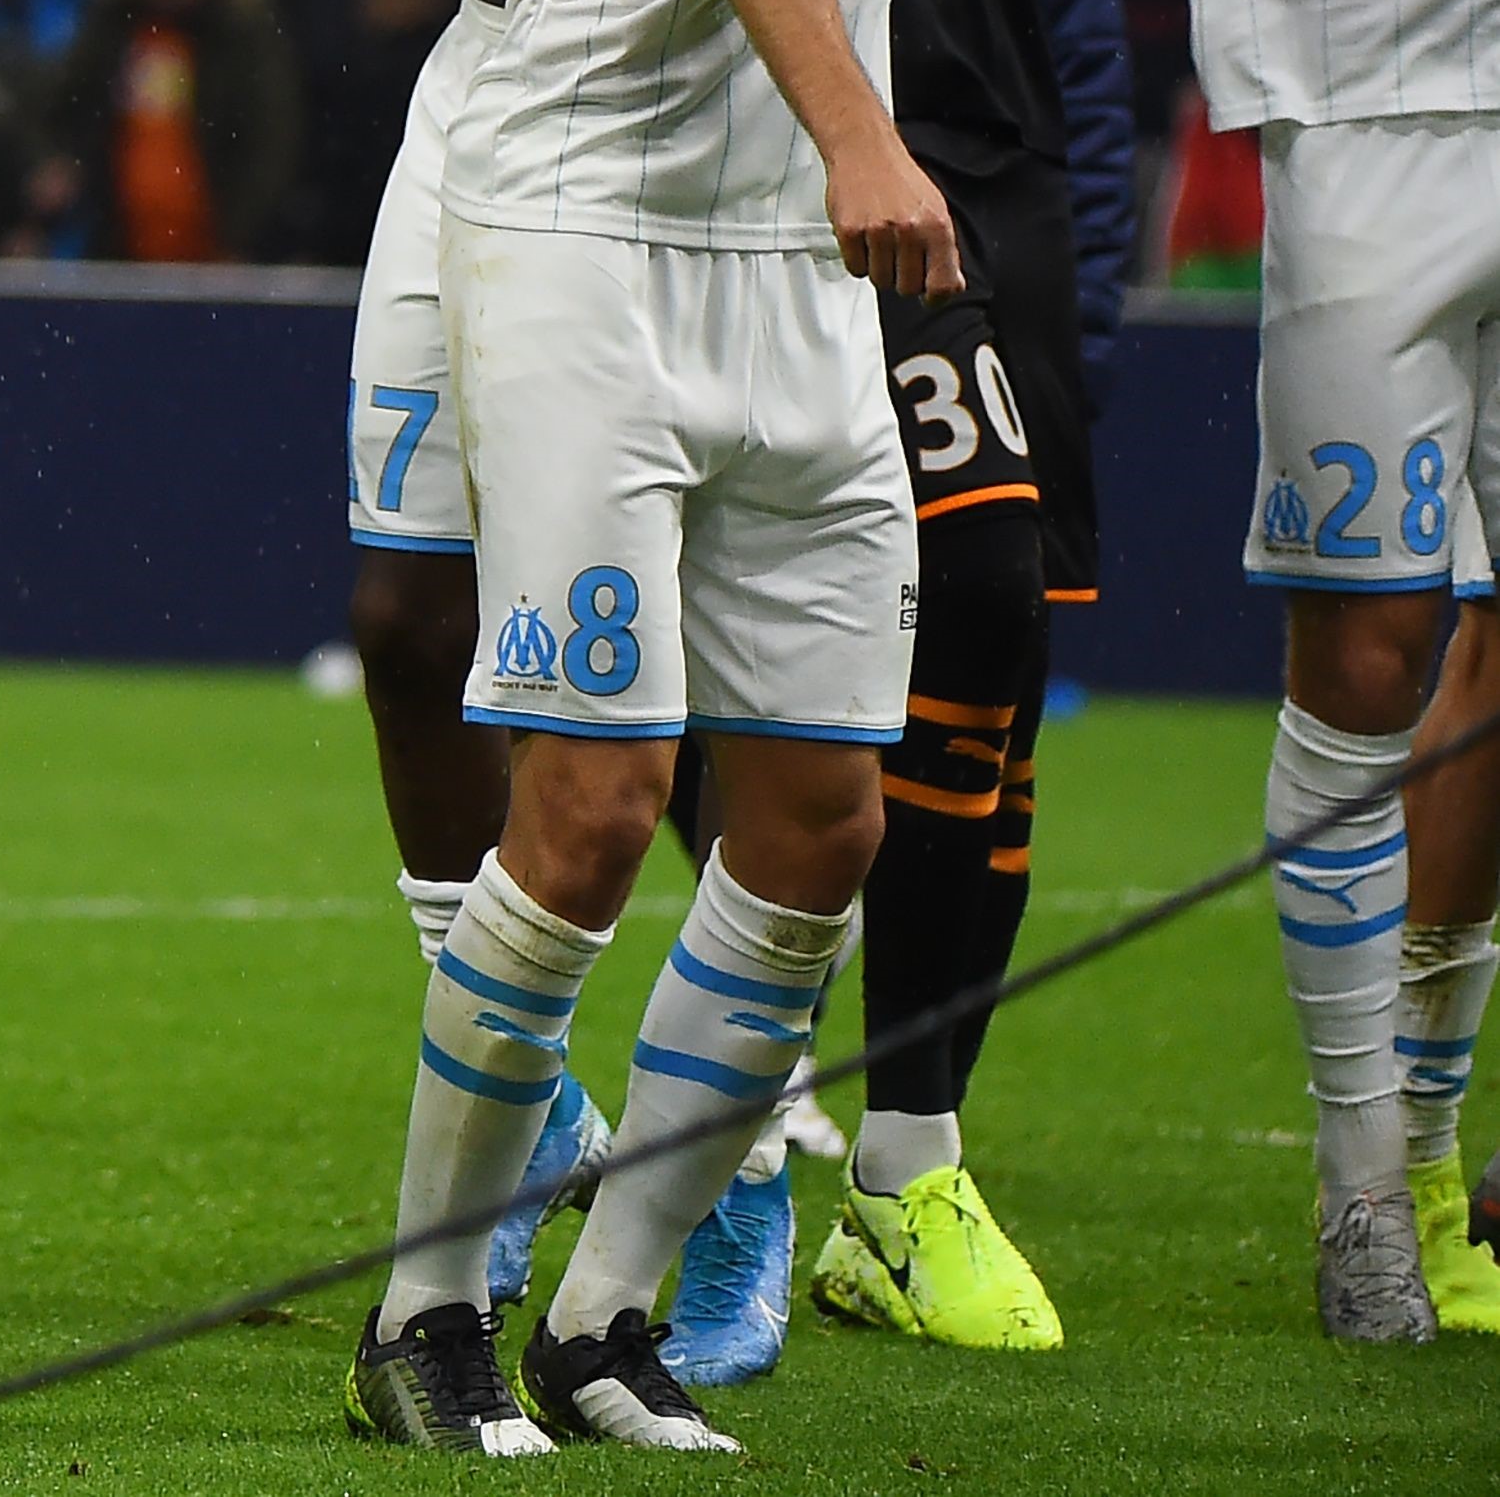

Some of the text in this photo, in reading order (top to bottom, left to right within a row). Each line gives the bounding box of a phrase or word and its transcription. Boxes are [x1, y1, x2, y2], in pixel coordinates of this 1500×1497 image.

[349, 380, 440, 513] 7
[892, 344, 1029, 471] 30
[1310, 438, 1446, 558] 28
[562, 565, 641, 696] 8
